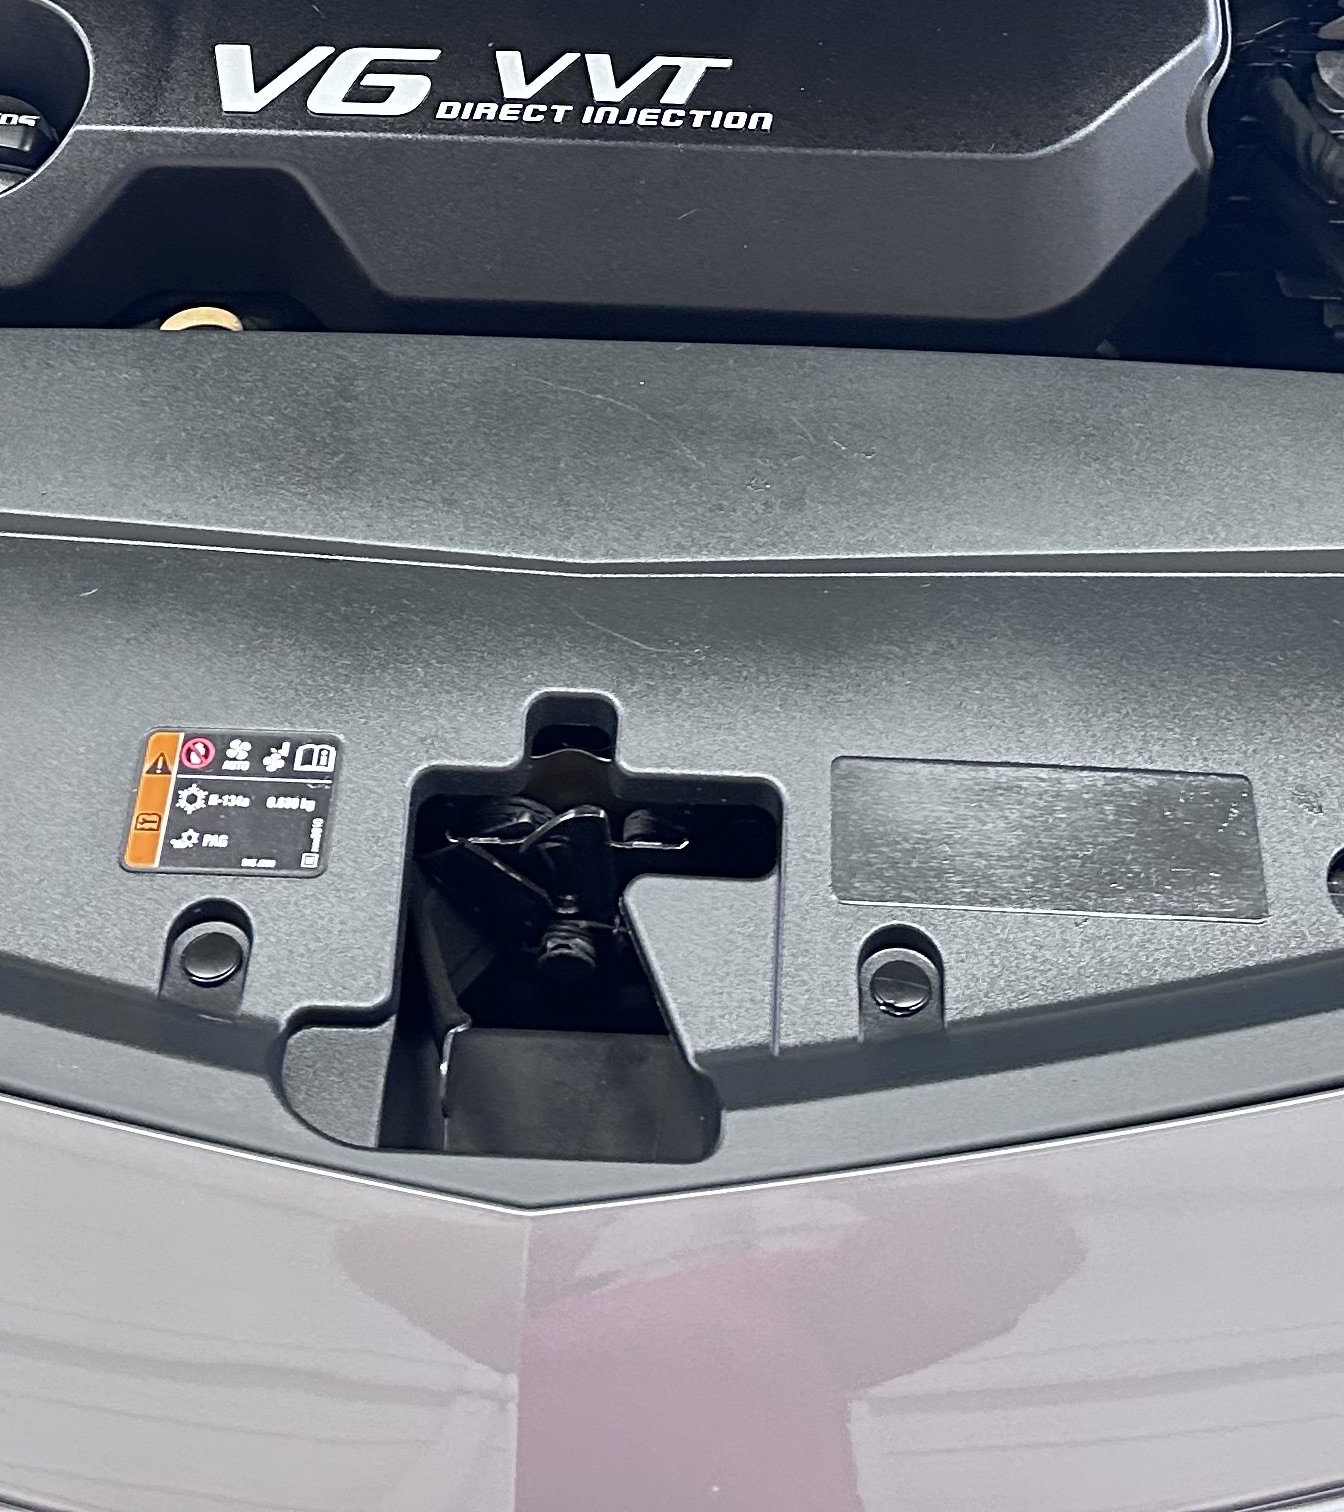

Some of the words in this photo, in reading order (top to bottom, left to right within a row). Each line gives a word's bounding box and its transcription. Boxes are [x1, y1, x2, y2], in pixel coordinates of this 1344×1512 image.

[214, 43, 442, 116] V6
[495, 50, 733, 105] VVT
[435, 101, 574, 123] DIRECT
[581, 106, 774, 131] INJECTION
[201, 833, 229, 848] PAG
